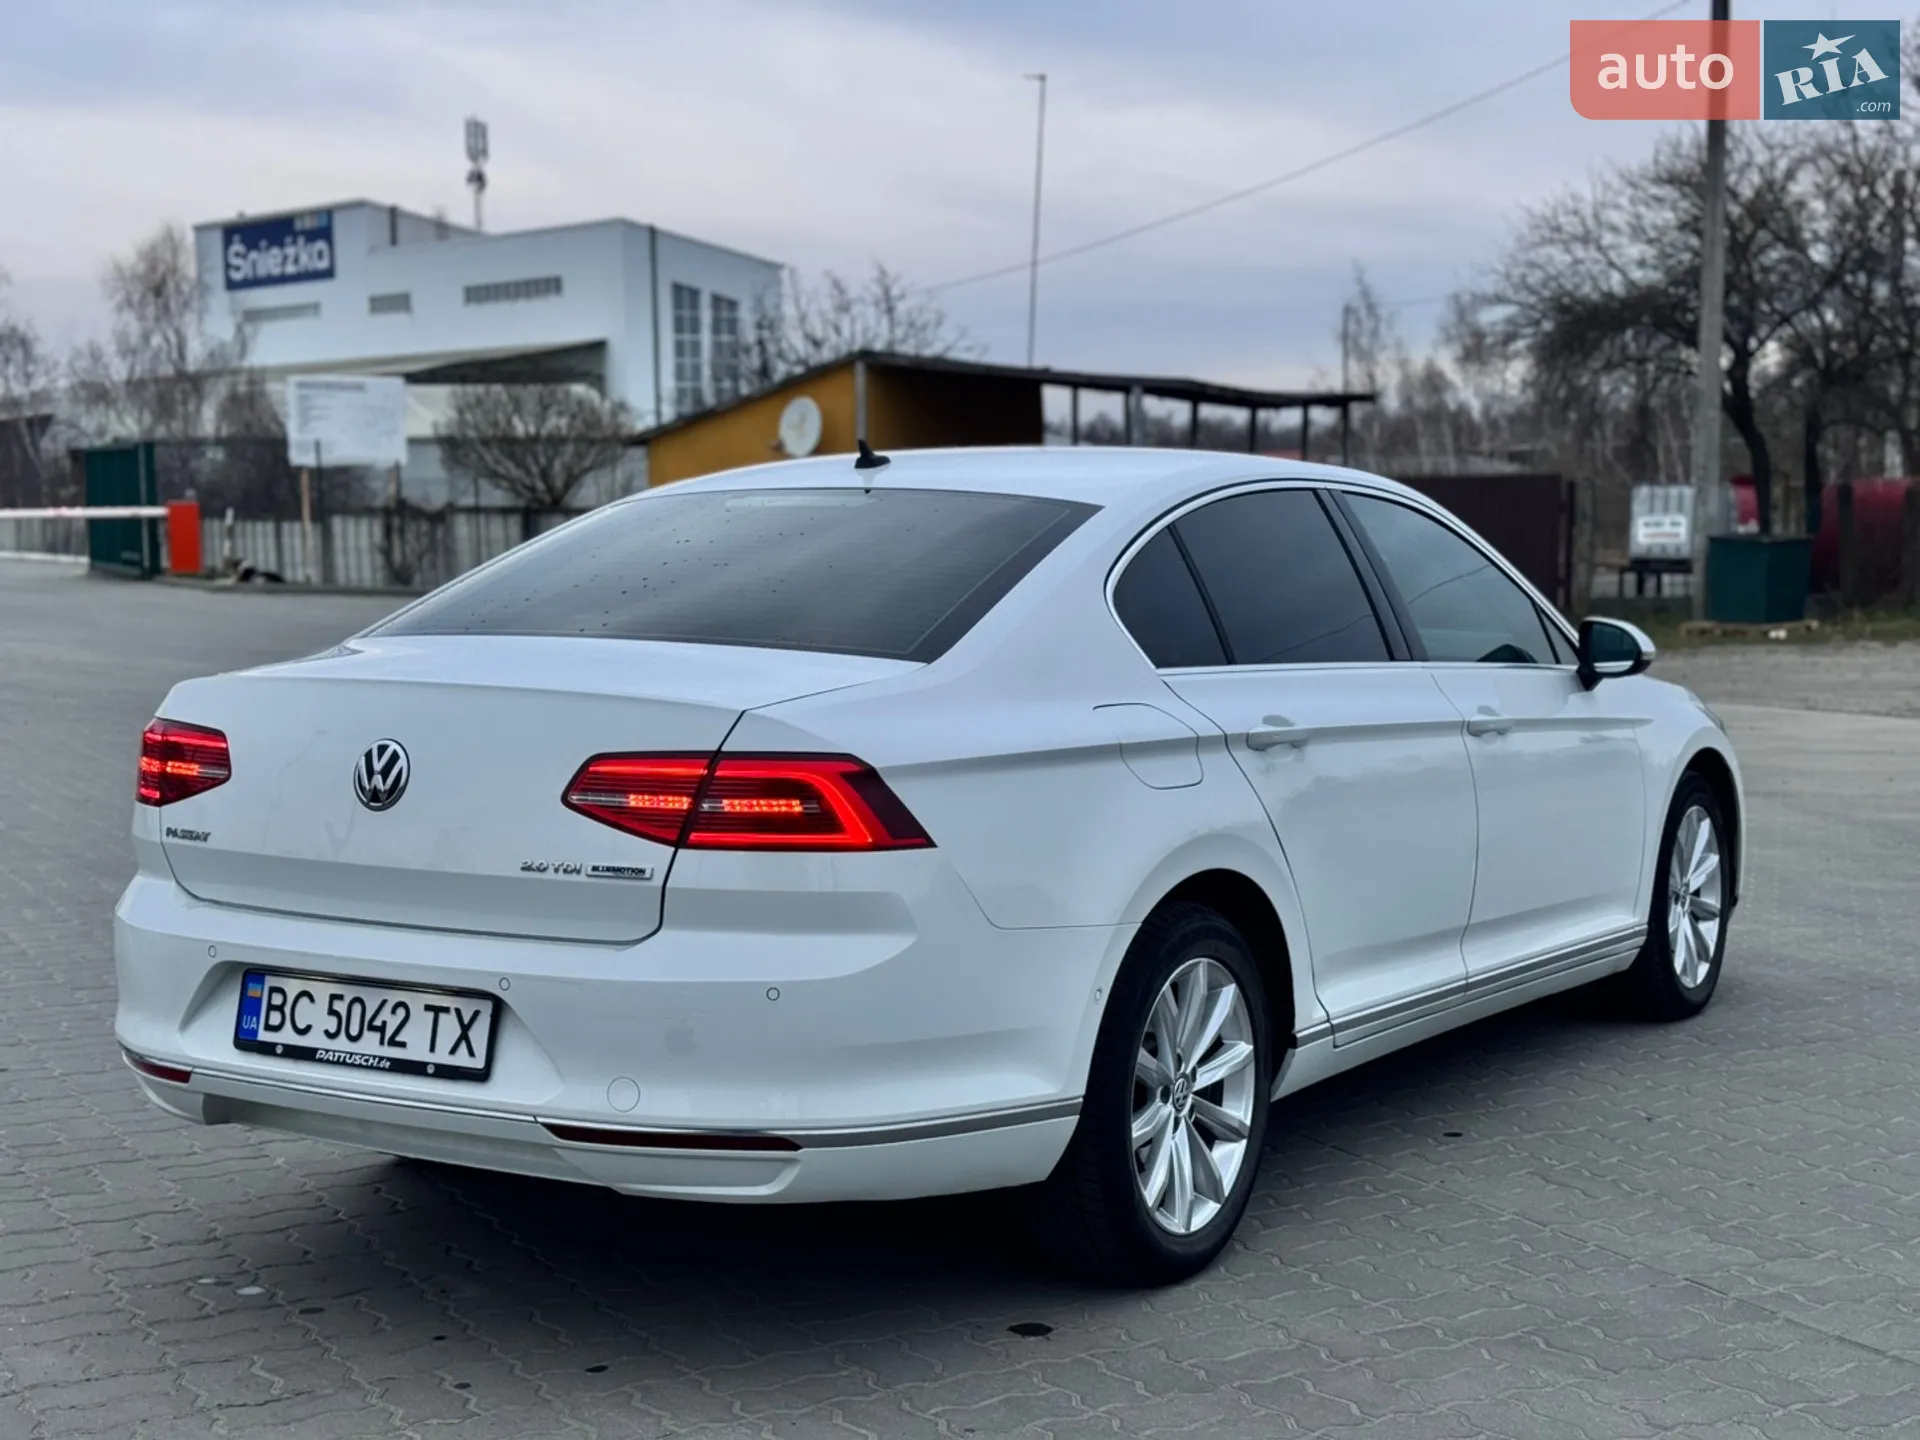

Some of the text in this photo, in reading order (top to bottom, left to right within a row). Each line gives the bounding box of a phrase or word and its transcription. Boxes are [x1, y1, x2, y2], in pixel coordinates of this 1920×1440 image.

[227, 233, 330, 281] Śnieżka
[520, 859, 582, 875] 2.0 TDI
[242, 1014, 258, 1031] UA
[264, 986, 482, 1058] BC 5042 TX
[315, 1049, 391, 1069] PATTUSCH.de
